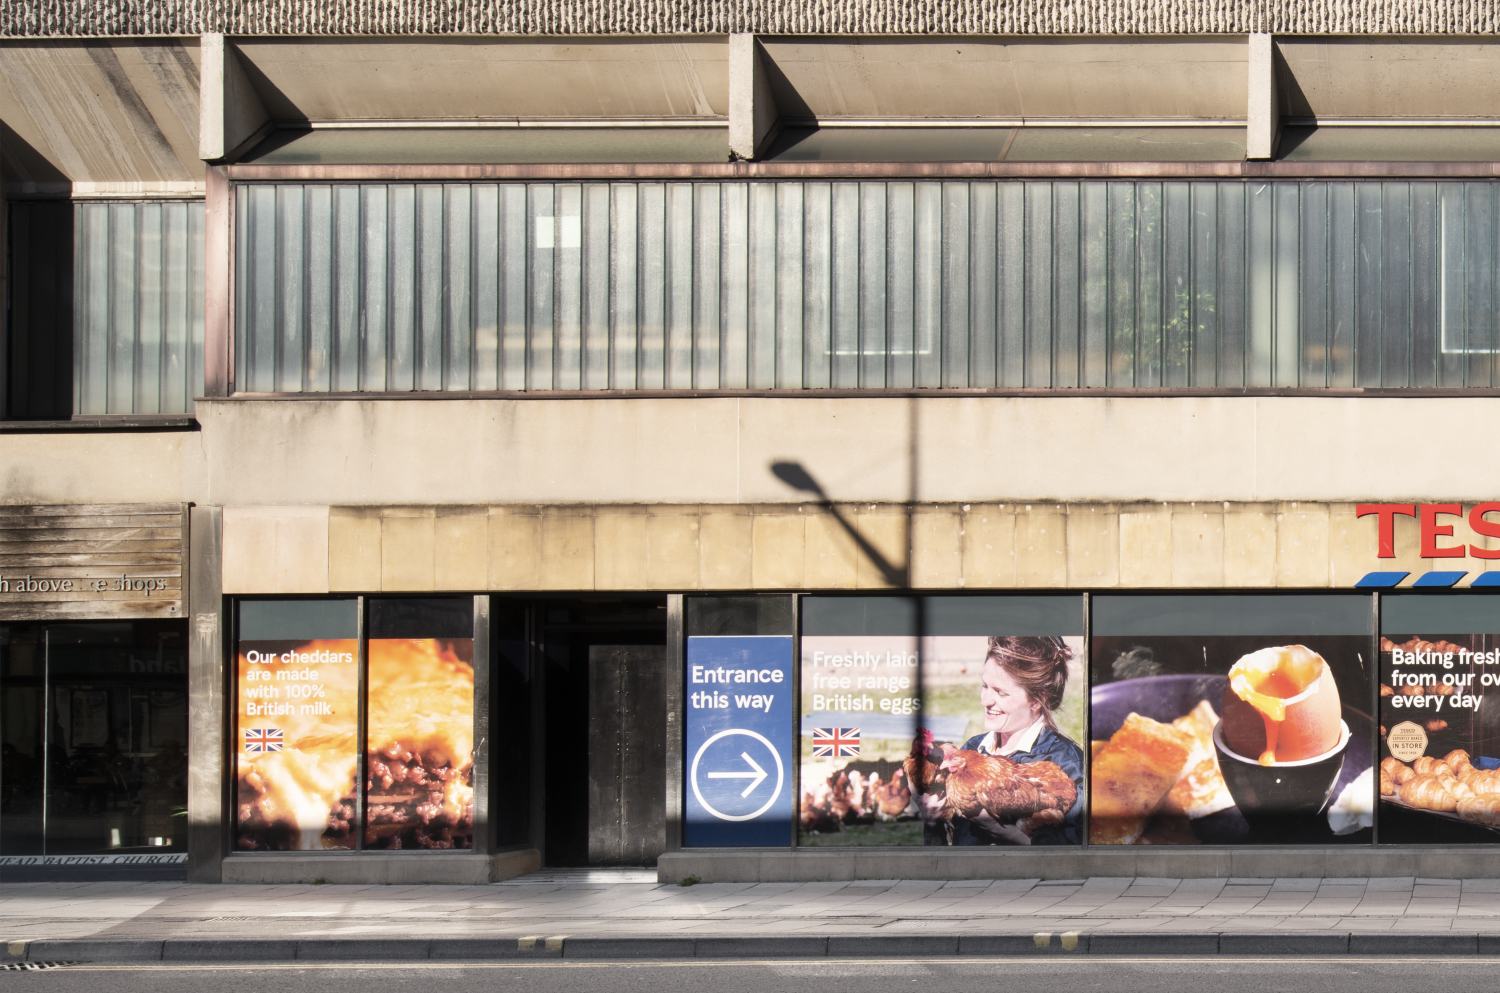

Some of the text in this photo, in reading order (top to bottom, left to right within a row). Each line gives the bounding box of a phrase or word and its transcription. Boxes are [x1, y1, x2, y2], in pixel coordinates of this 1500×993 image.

[16, 575, 73, 592] above
[112, 573, 166, 596] shops
[246, 649, 353, 664] Our cheddars
[813, 650, 919, 671] Freshly laid
[1392, 648, 1454, 669] Baking
[246, 667, 319, 681] are made
[692, 665, 784, 684] Entrance
[812, 673, 911, 694] free range
[1391, 669, 1437, 687] from
[1442, 672, 1476, 687] our
[246, 683, 325, 699] with 100%
[246, 701, 336, 716] British milk.
[691, 690, 774, 713] this way
[812, 694, 921, 716] British eggs
[1391, 691, 1482, 712] every day
[44, 856, 109, 865] BAPTIST
[112, 855, 182, 864] CHURCH
